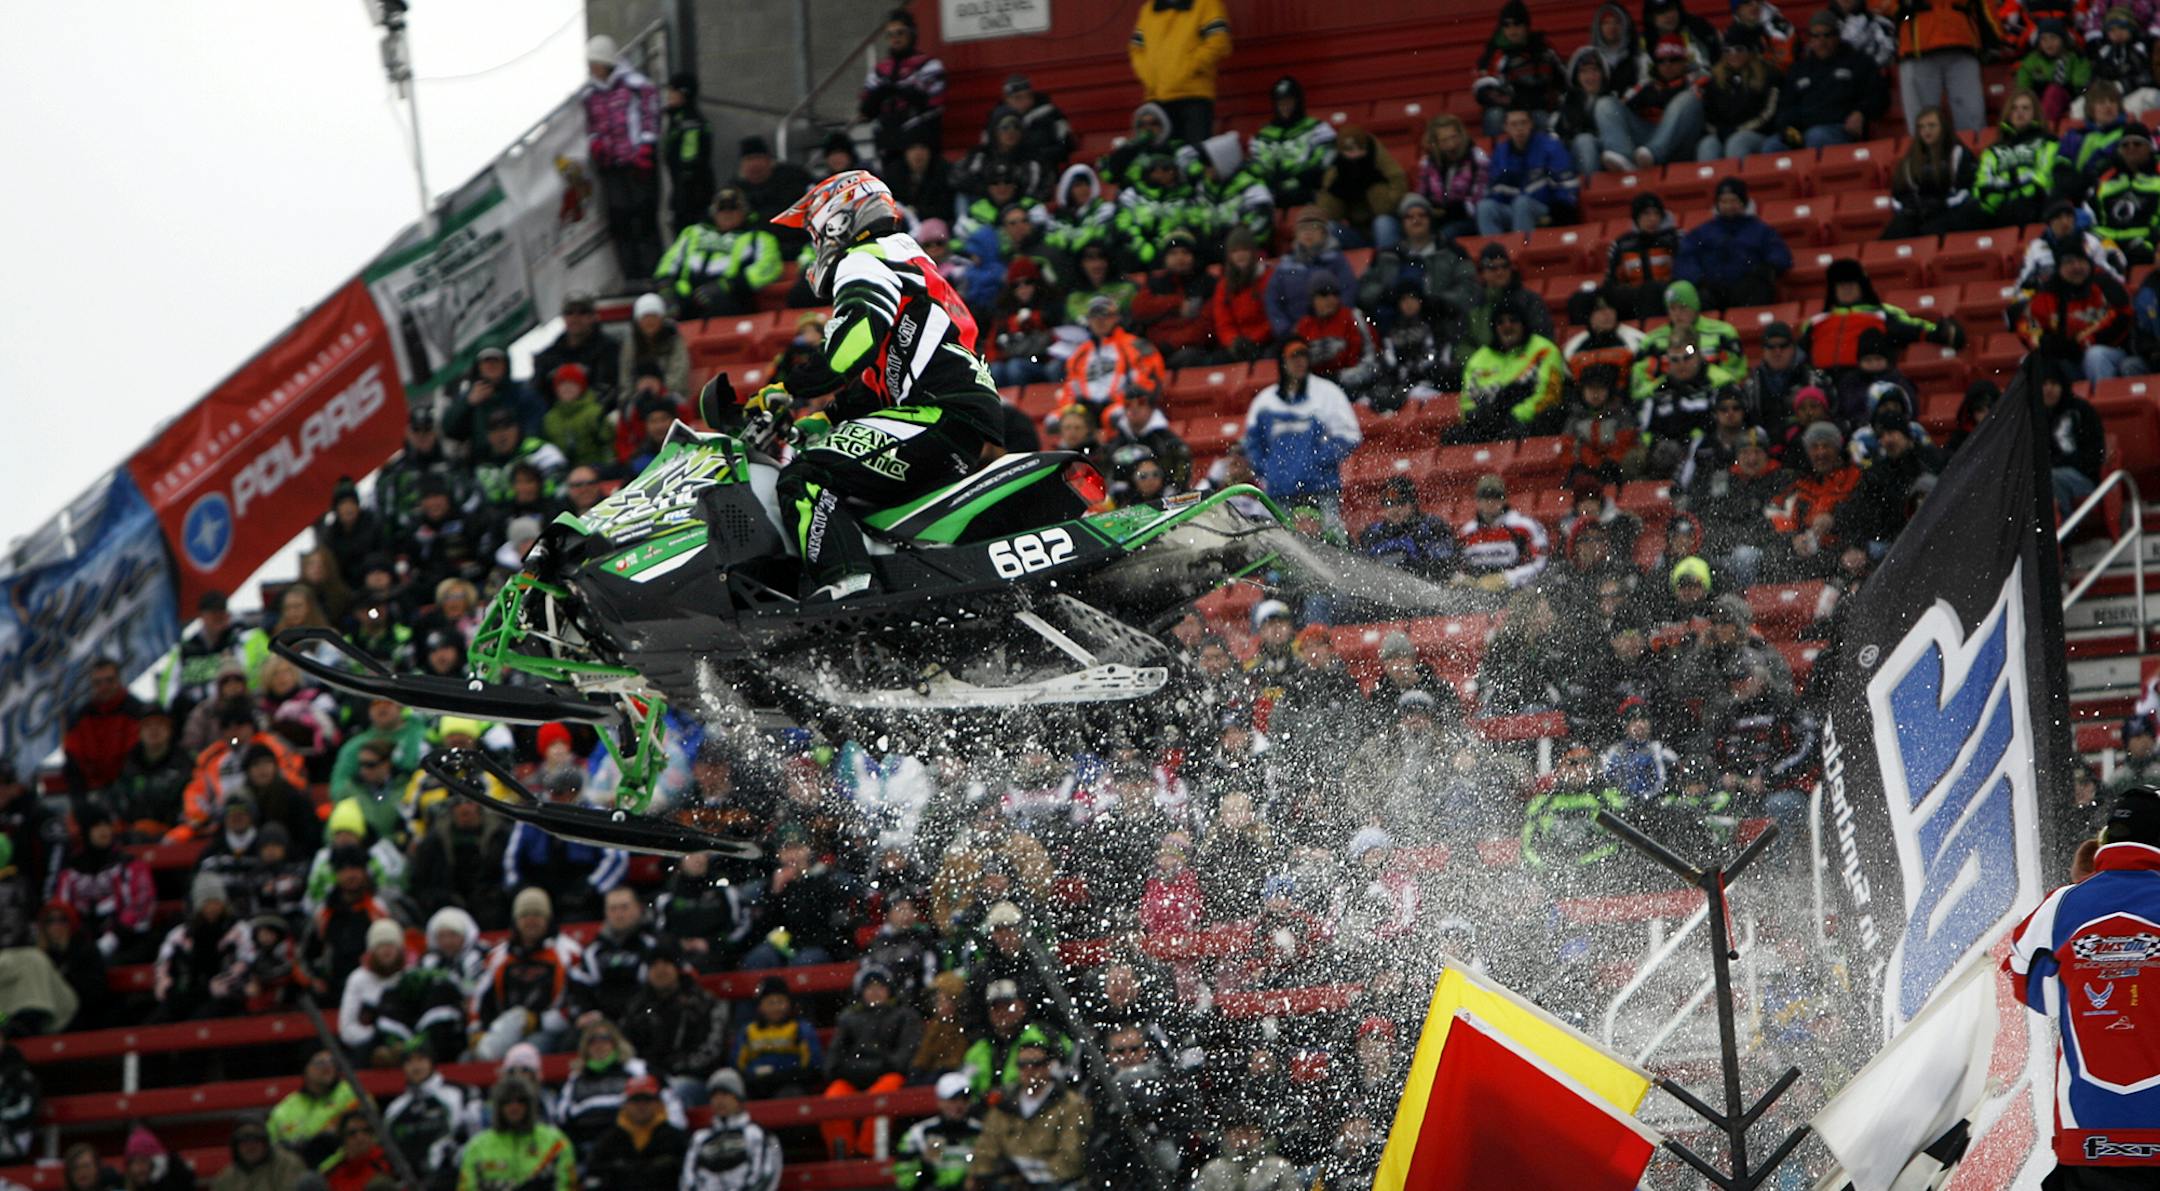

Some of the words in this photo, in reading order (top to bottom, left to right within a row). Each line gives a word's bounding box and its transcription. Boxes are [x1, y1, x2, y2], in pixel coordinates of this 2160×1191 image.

[897, 313, 918, 348] CAT
[231, 362, 386, 518] POLARIS
[839, 420, 898, 448] TEAM
[818, 433, 910, 481] RCIC
[988, 527, 1079, 580] 682
[2090, 941, 2146, 954] AMSOIL
